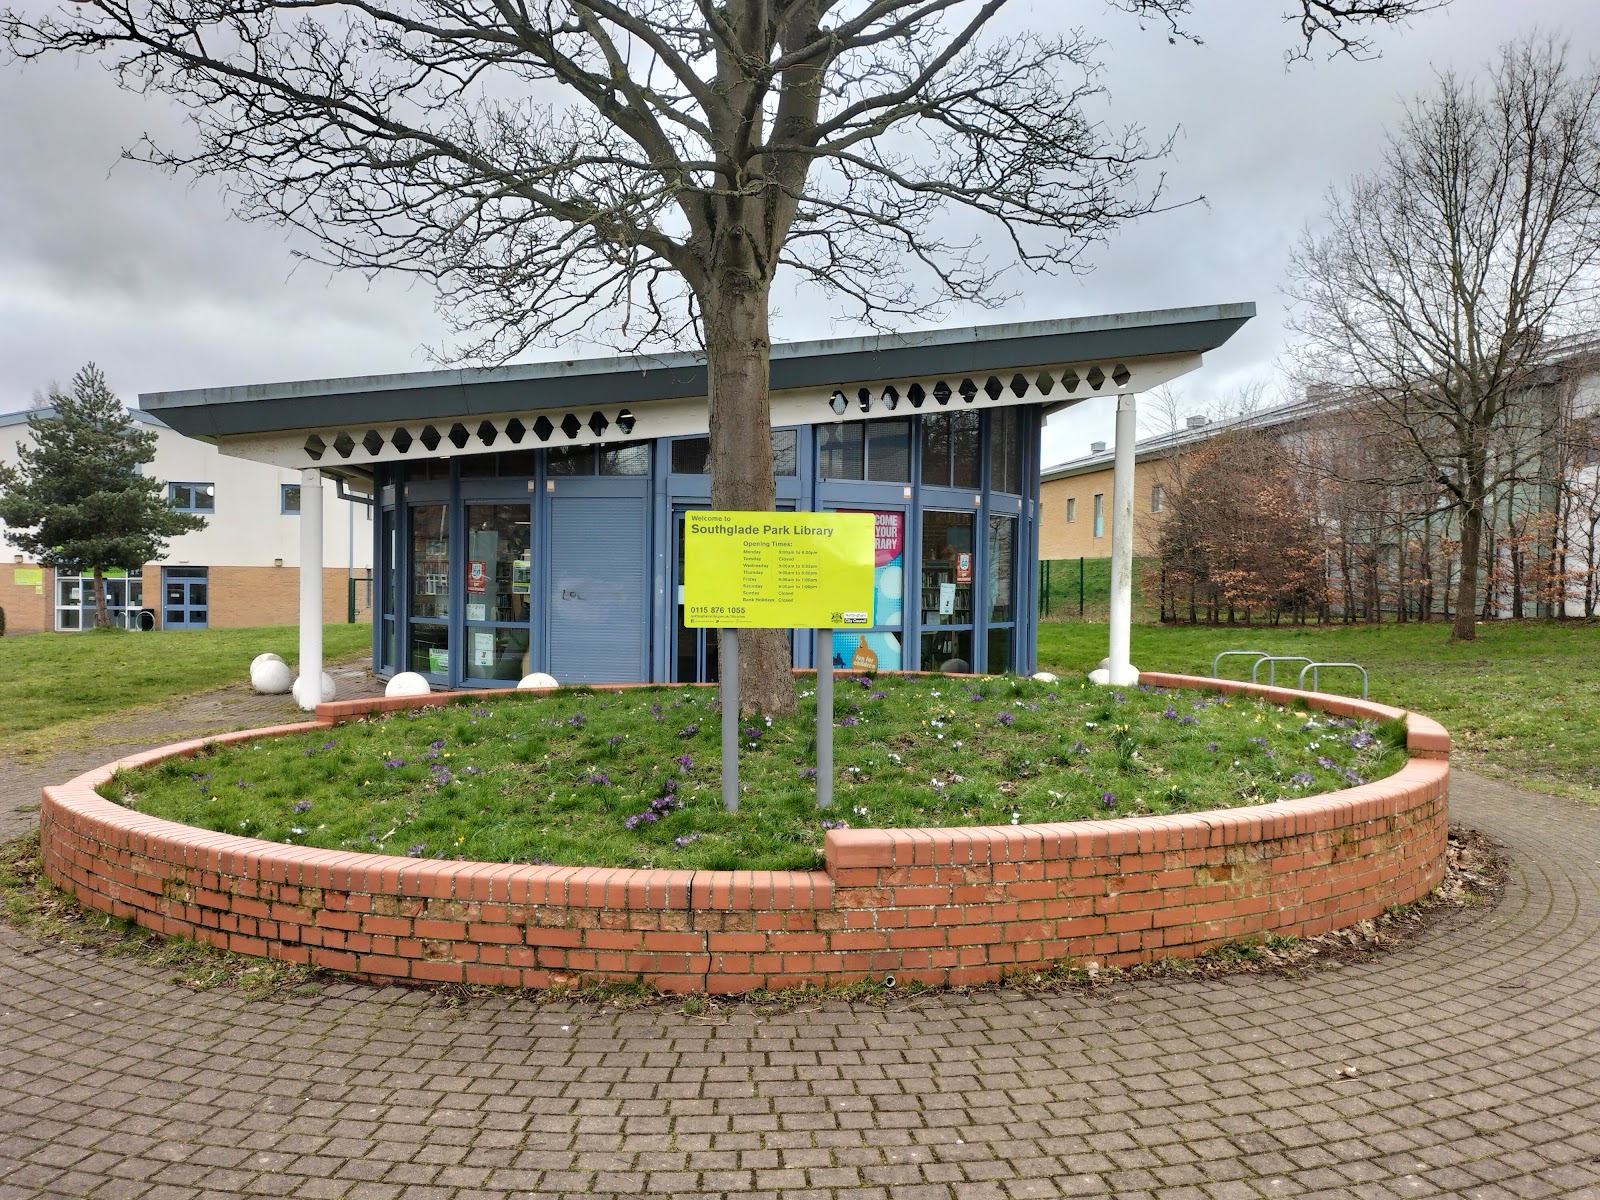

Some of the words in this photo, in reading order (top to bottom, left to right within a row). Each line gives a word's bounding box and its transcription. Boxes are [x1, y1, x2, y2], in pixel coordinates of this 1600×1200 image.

[691, 523, 760, 536] Southglade
[763, 525, 790, 535] Park
[793, 525, 834, 537] Library
[875, 526, 898, 538] YOUR
[854, 660, 876, 668] children
